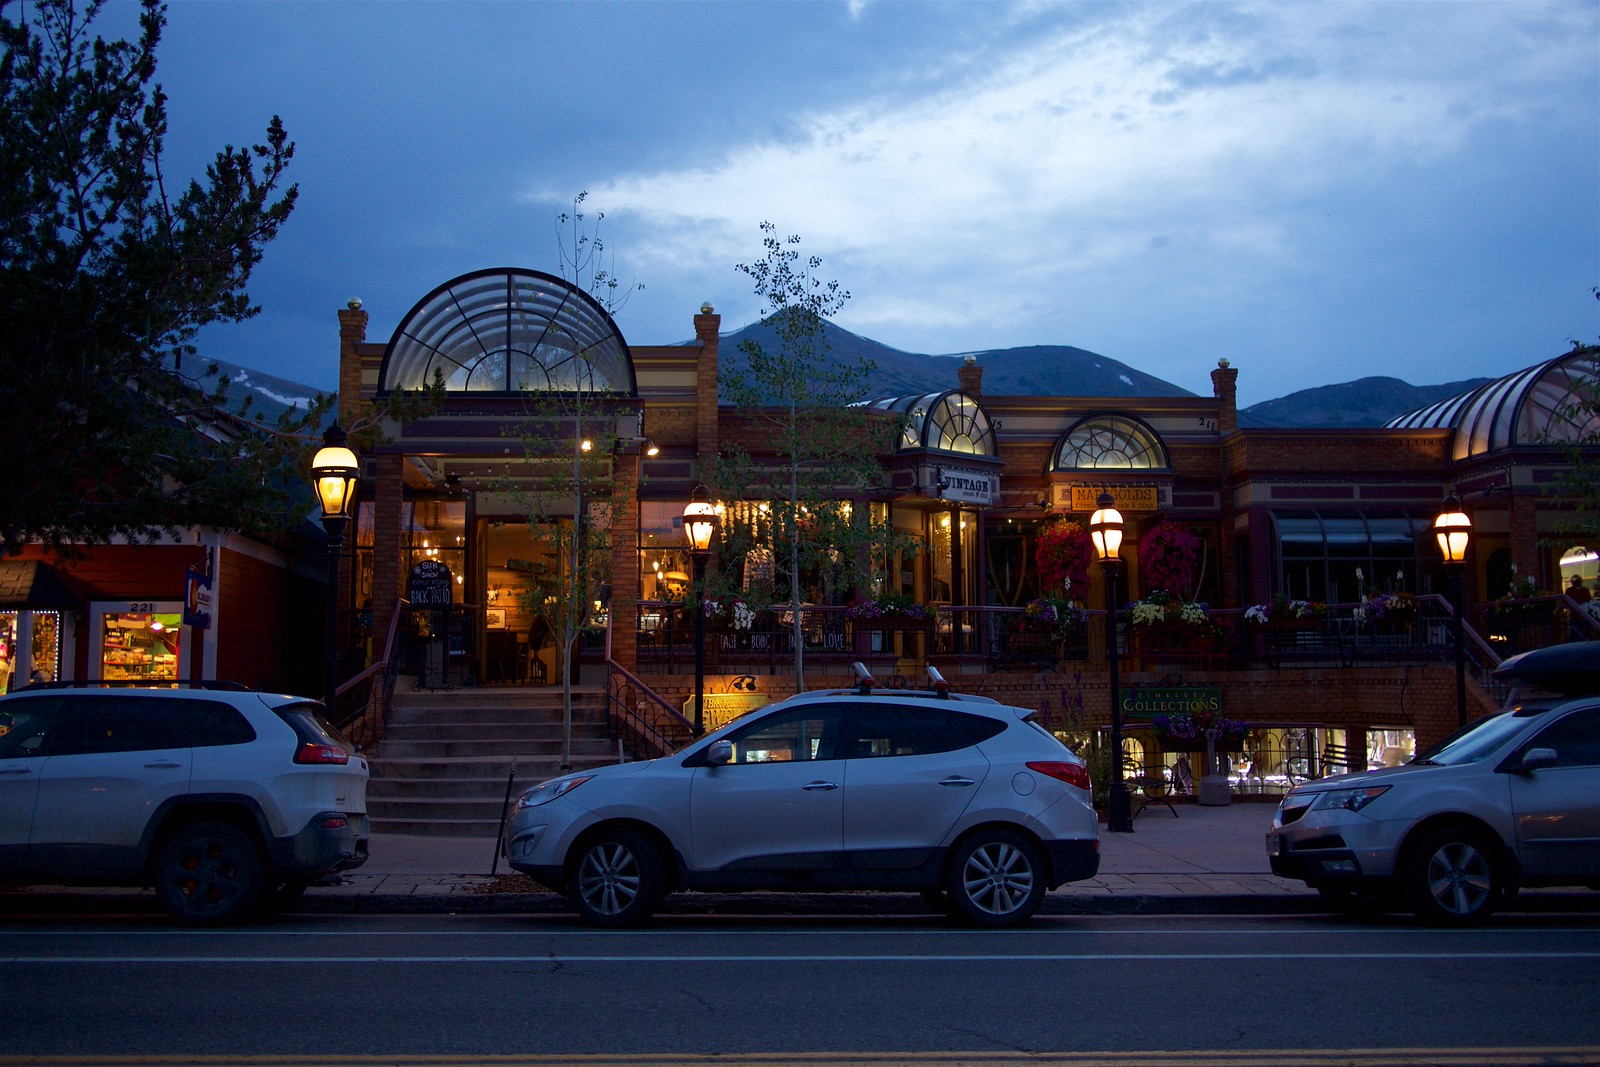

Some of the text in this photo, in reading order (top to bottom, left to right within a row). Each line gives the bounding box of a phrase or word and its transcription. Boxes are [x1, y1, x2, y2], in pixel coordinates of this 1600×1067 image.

[1199, 417, 1215, 431] 211
[944, 476, 989, 492] VINTAGE
[1077, 488, 1152, 501] MARGOLDS
[421, 561, 438, 570] SUN
[411, 587, 451, 605] BACK PATIO
[130, 603, 153, 612] 221
[823, 633, 845, 649] LOVE
[1122, 697, 1219, 712] COLLECTIONS
